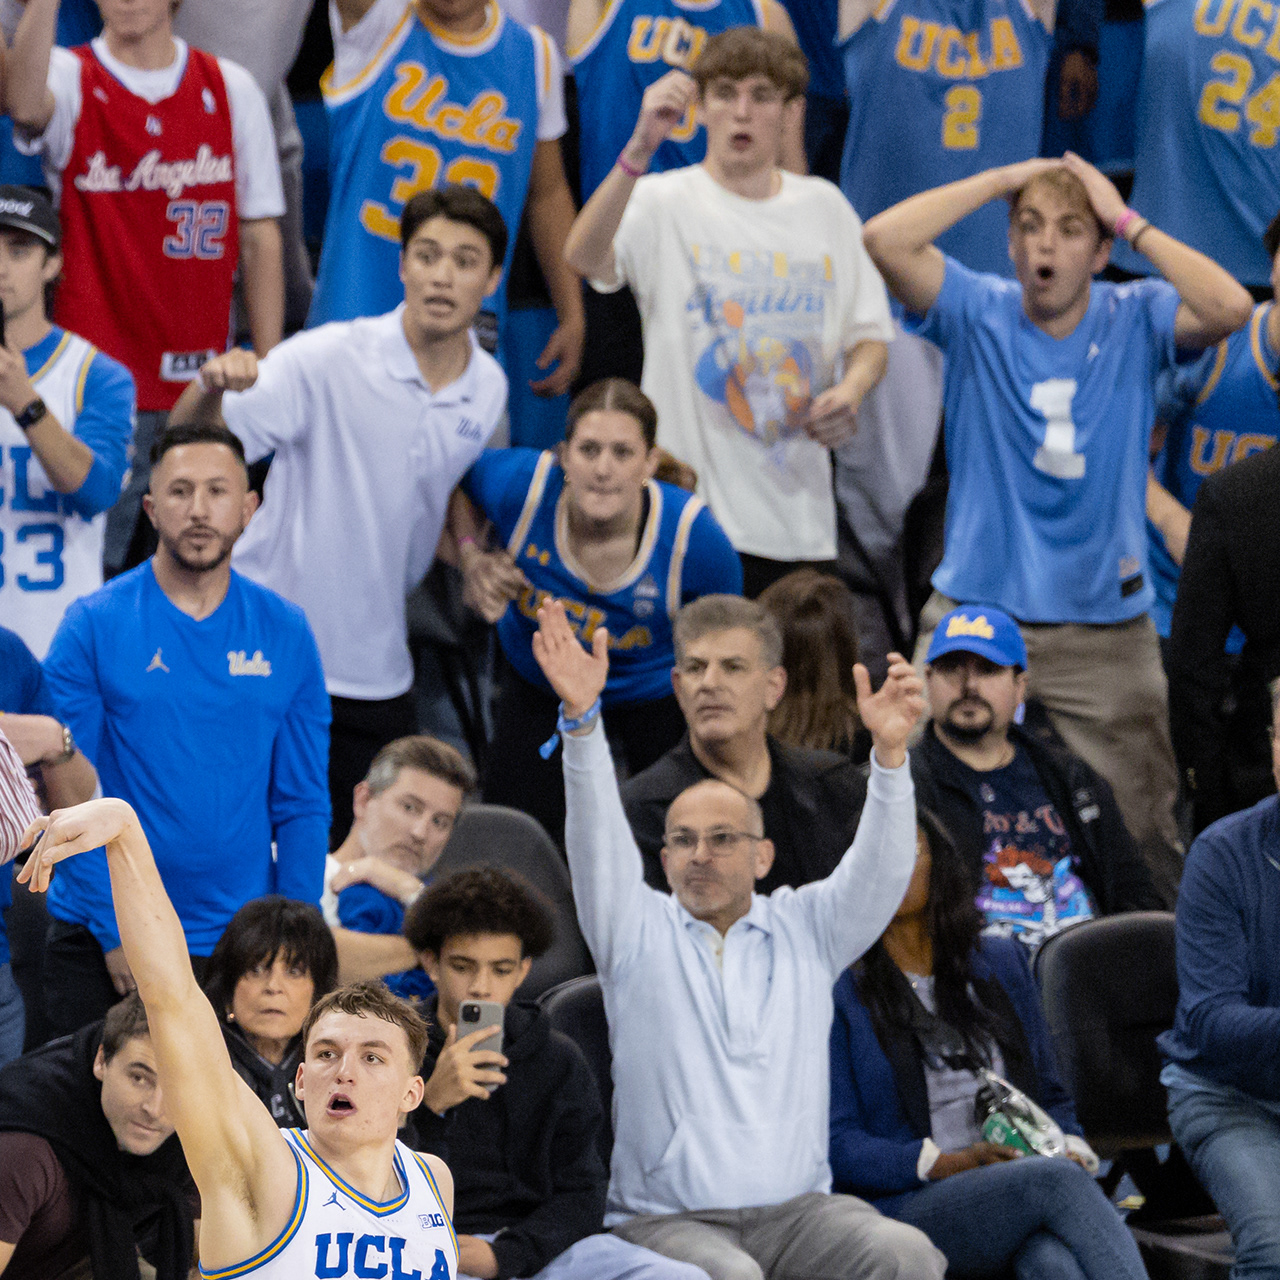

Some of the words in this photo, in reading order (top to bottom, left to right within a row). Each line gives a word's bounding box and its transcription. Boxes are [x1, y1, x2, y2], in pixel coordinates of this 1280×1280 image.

[895, 14, 1025, 80] UCLA
[1192, 0, 1280, 62] UCL
[383, 61, 523, 155] Ucla
[162, 199, 230, 260] 32
